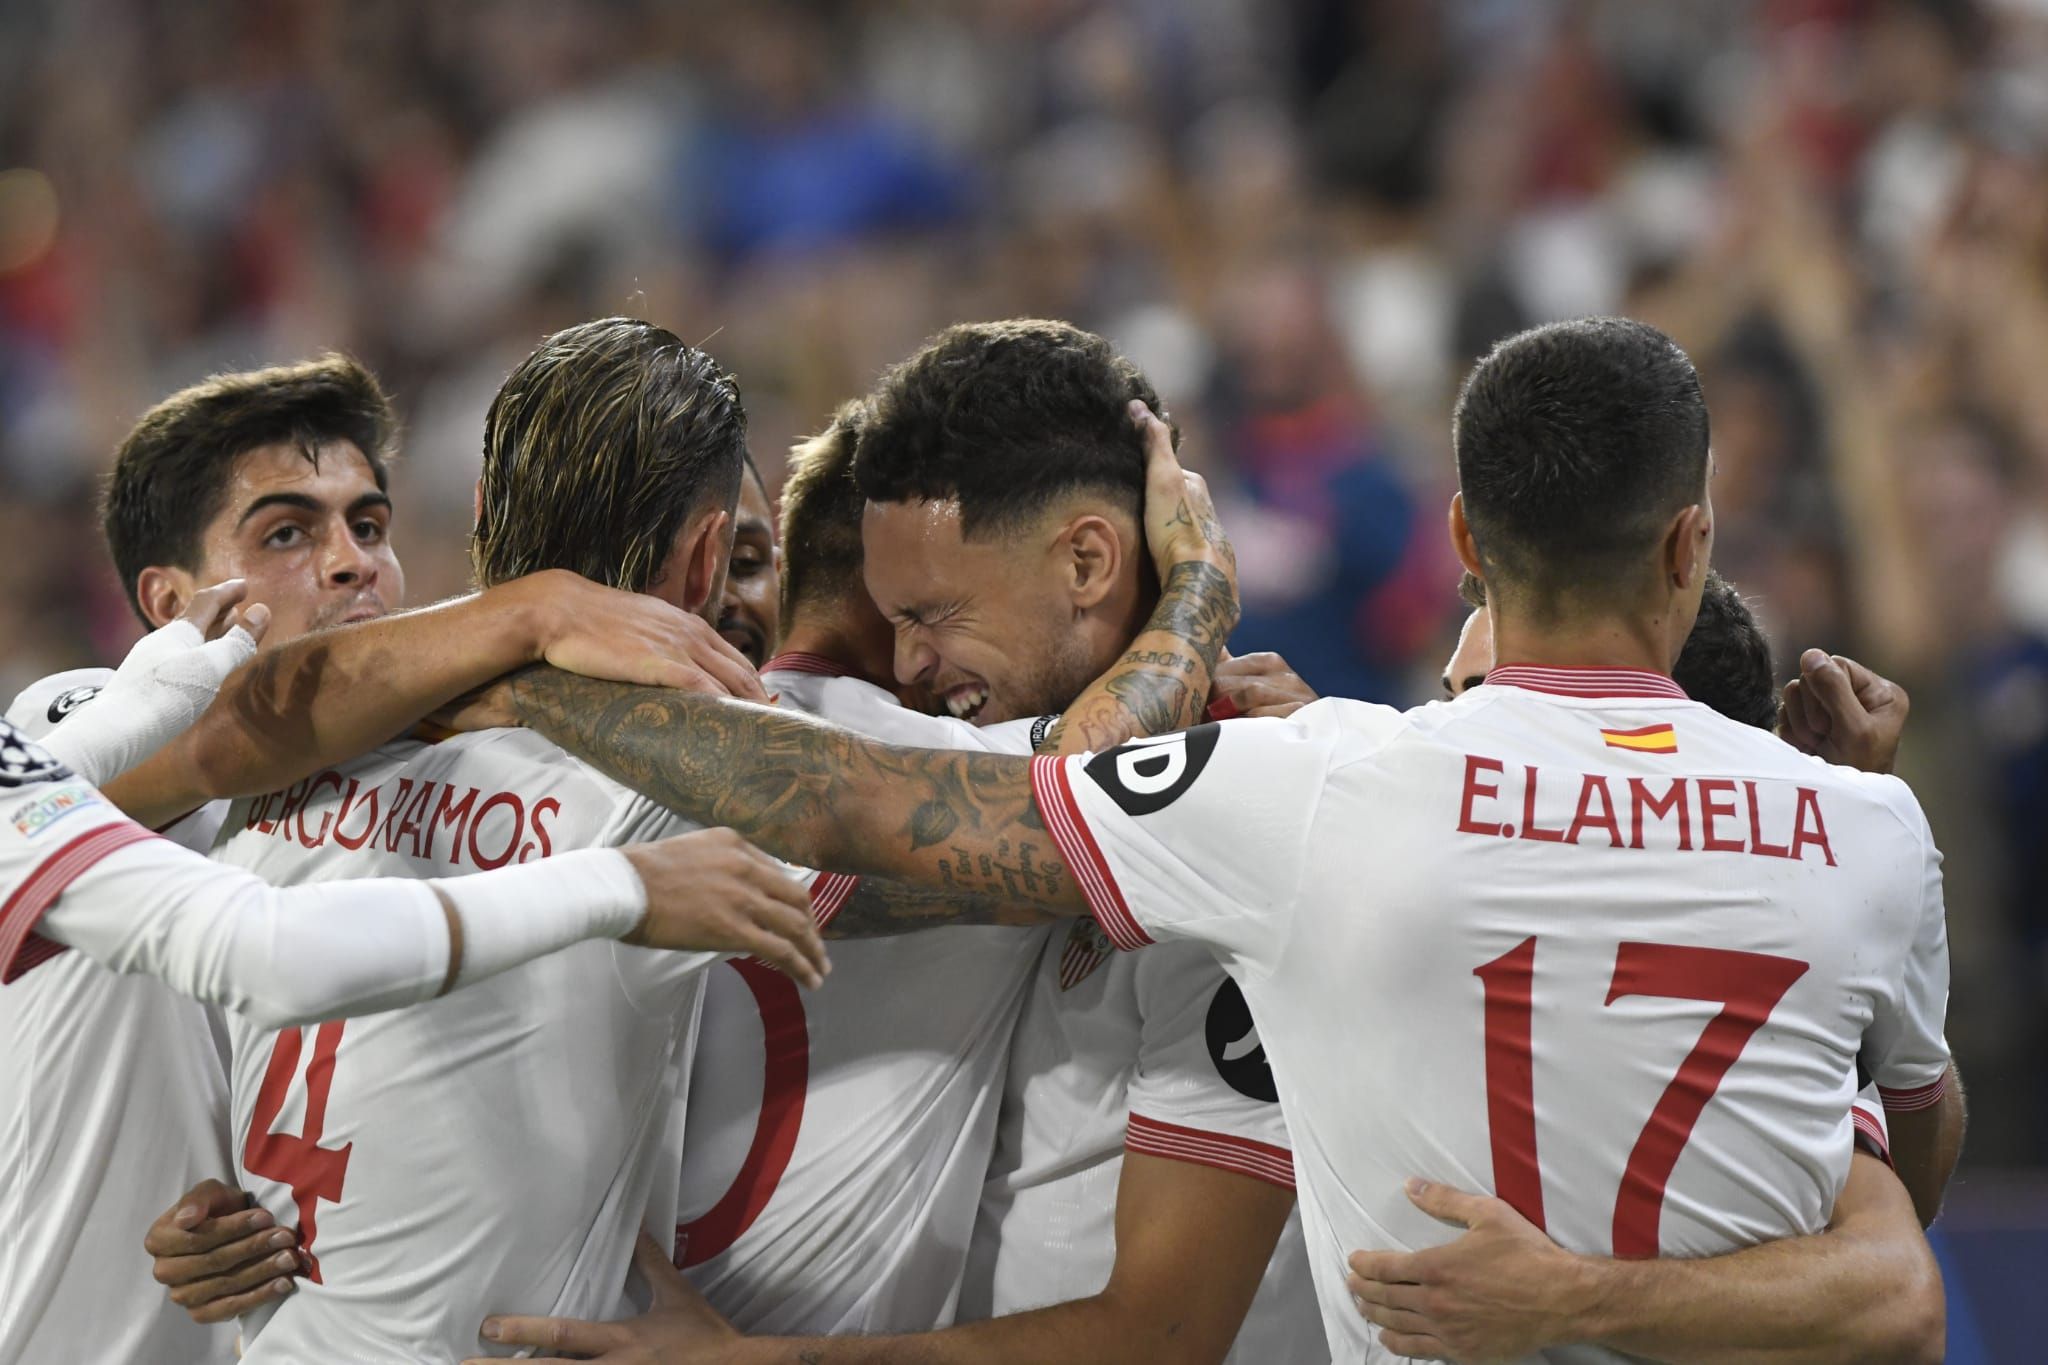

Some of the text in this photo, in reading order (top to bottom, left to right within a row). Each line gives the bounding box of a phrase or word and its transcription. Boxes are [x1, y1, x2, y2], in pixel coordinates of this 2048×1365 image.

[368, 777, 562, 870] RAMOS
[1456, 754, 1839, 867] E.LAMELA
[242, 1017, 353, 1286] 4
[1472, 934, 1811, 1261] 17
